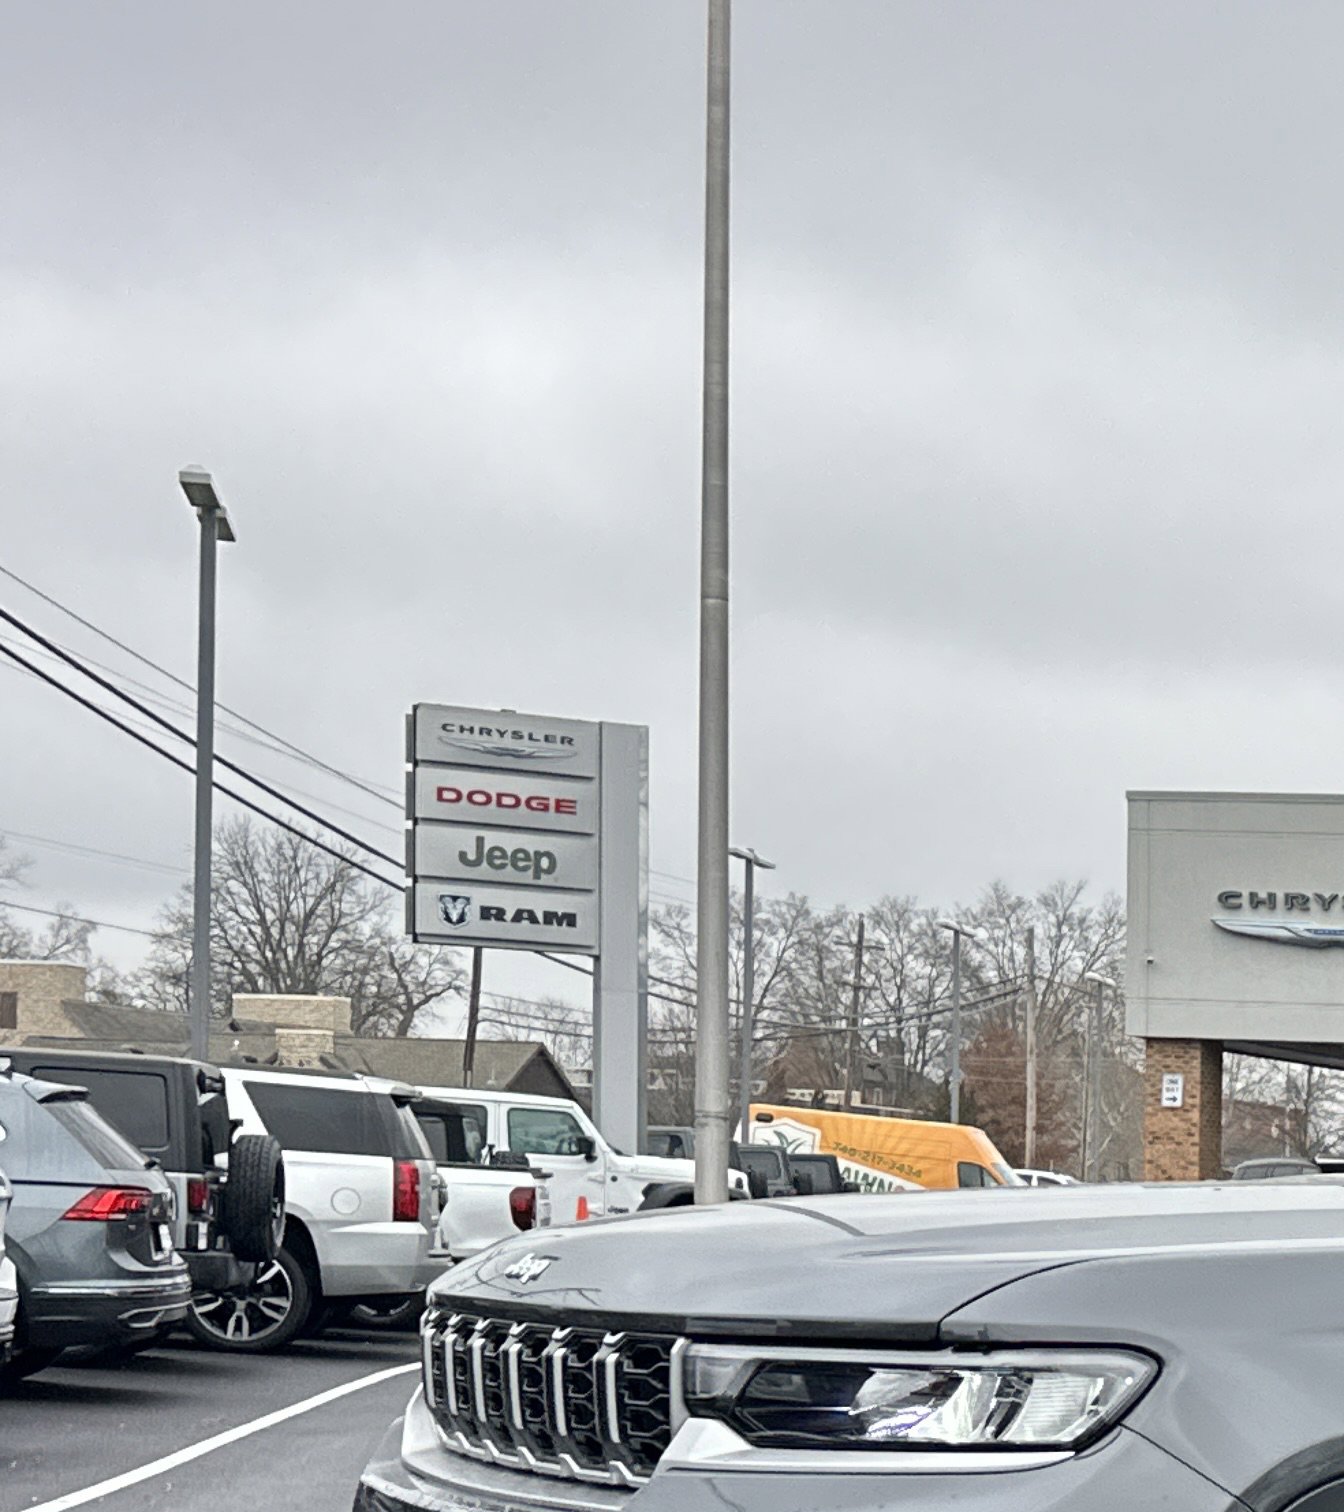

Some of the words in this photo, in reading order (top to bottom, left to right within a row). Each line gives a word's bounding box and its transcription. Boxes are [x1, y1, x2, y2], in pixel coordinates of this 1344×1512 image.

[440, 722, 575, 747] CHRYSLER
[436, 785, 578, 816] DODGE
[458, 835, 557, 881] Jeep
[479, 904, 578, 929] RAM
